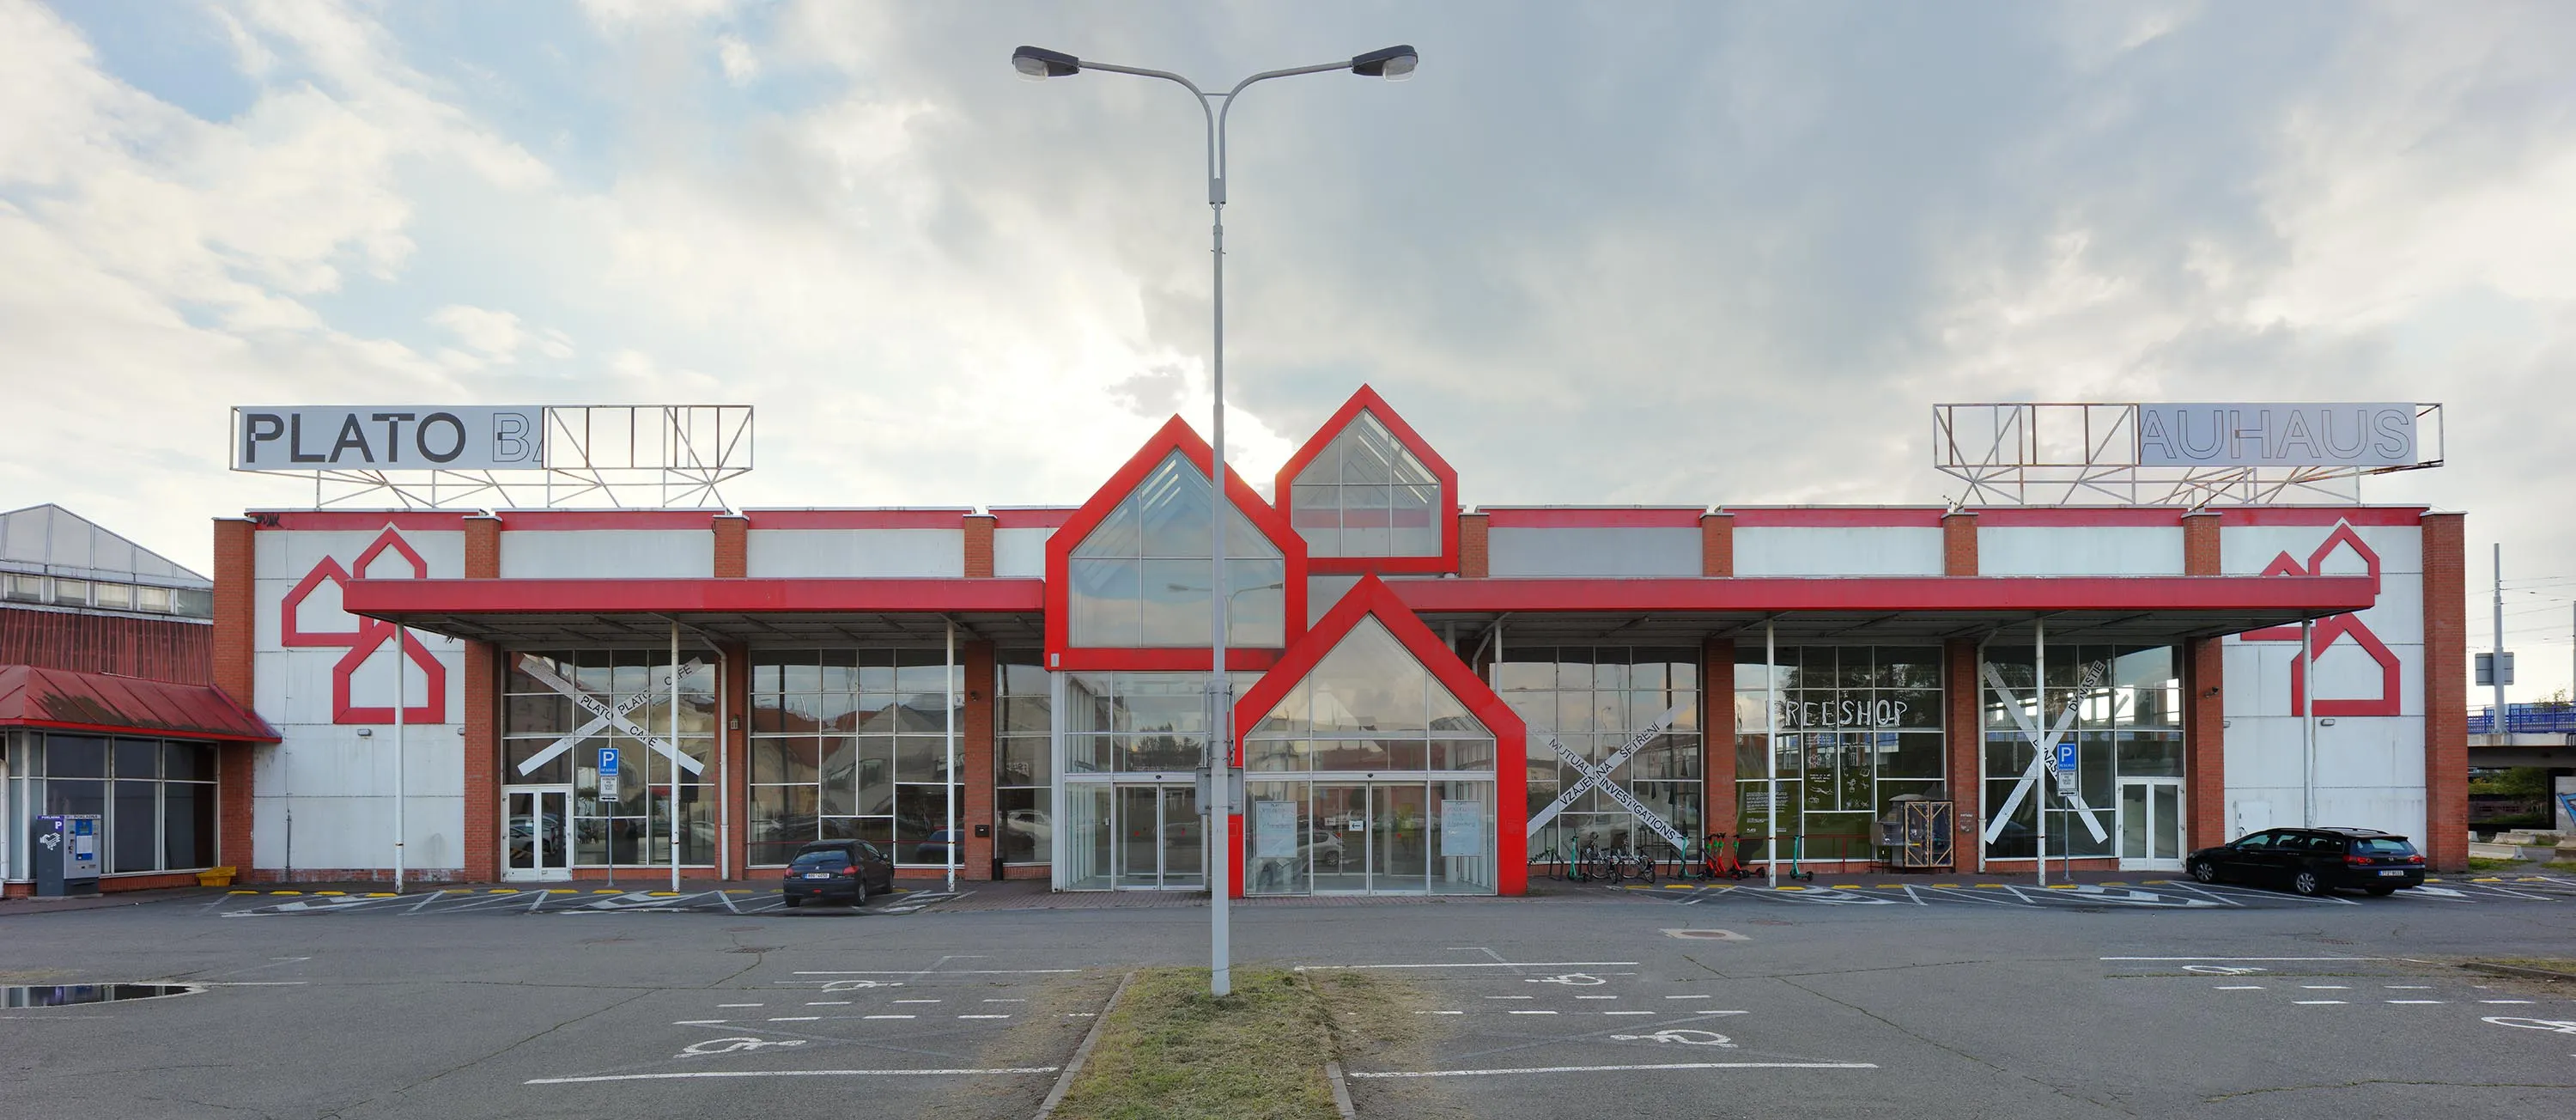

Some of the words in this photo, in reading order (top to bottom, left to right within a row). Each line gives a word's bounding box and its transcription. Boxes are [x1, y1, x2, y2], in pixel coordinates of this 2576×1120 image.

[246, 412, 466, 463] PLATO
[2140, 409, 2410, 459] AUHAUS
[2069, 662, 2105, 712] DYNASTIE
[580, 695, 614, 720] PLATO
[617, 690, 652, 714] PLATO
[603, 751, 615, 767] P
[2061, 746, 2073, 762] P
[1548, 738, 1589, 775] MUTUAL
[1599, 777, 1676, 840] INVESTIGATIONS
[54, 821, 63, 830] P
